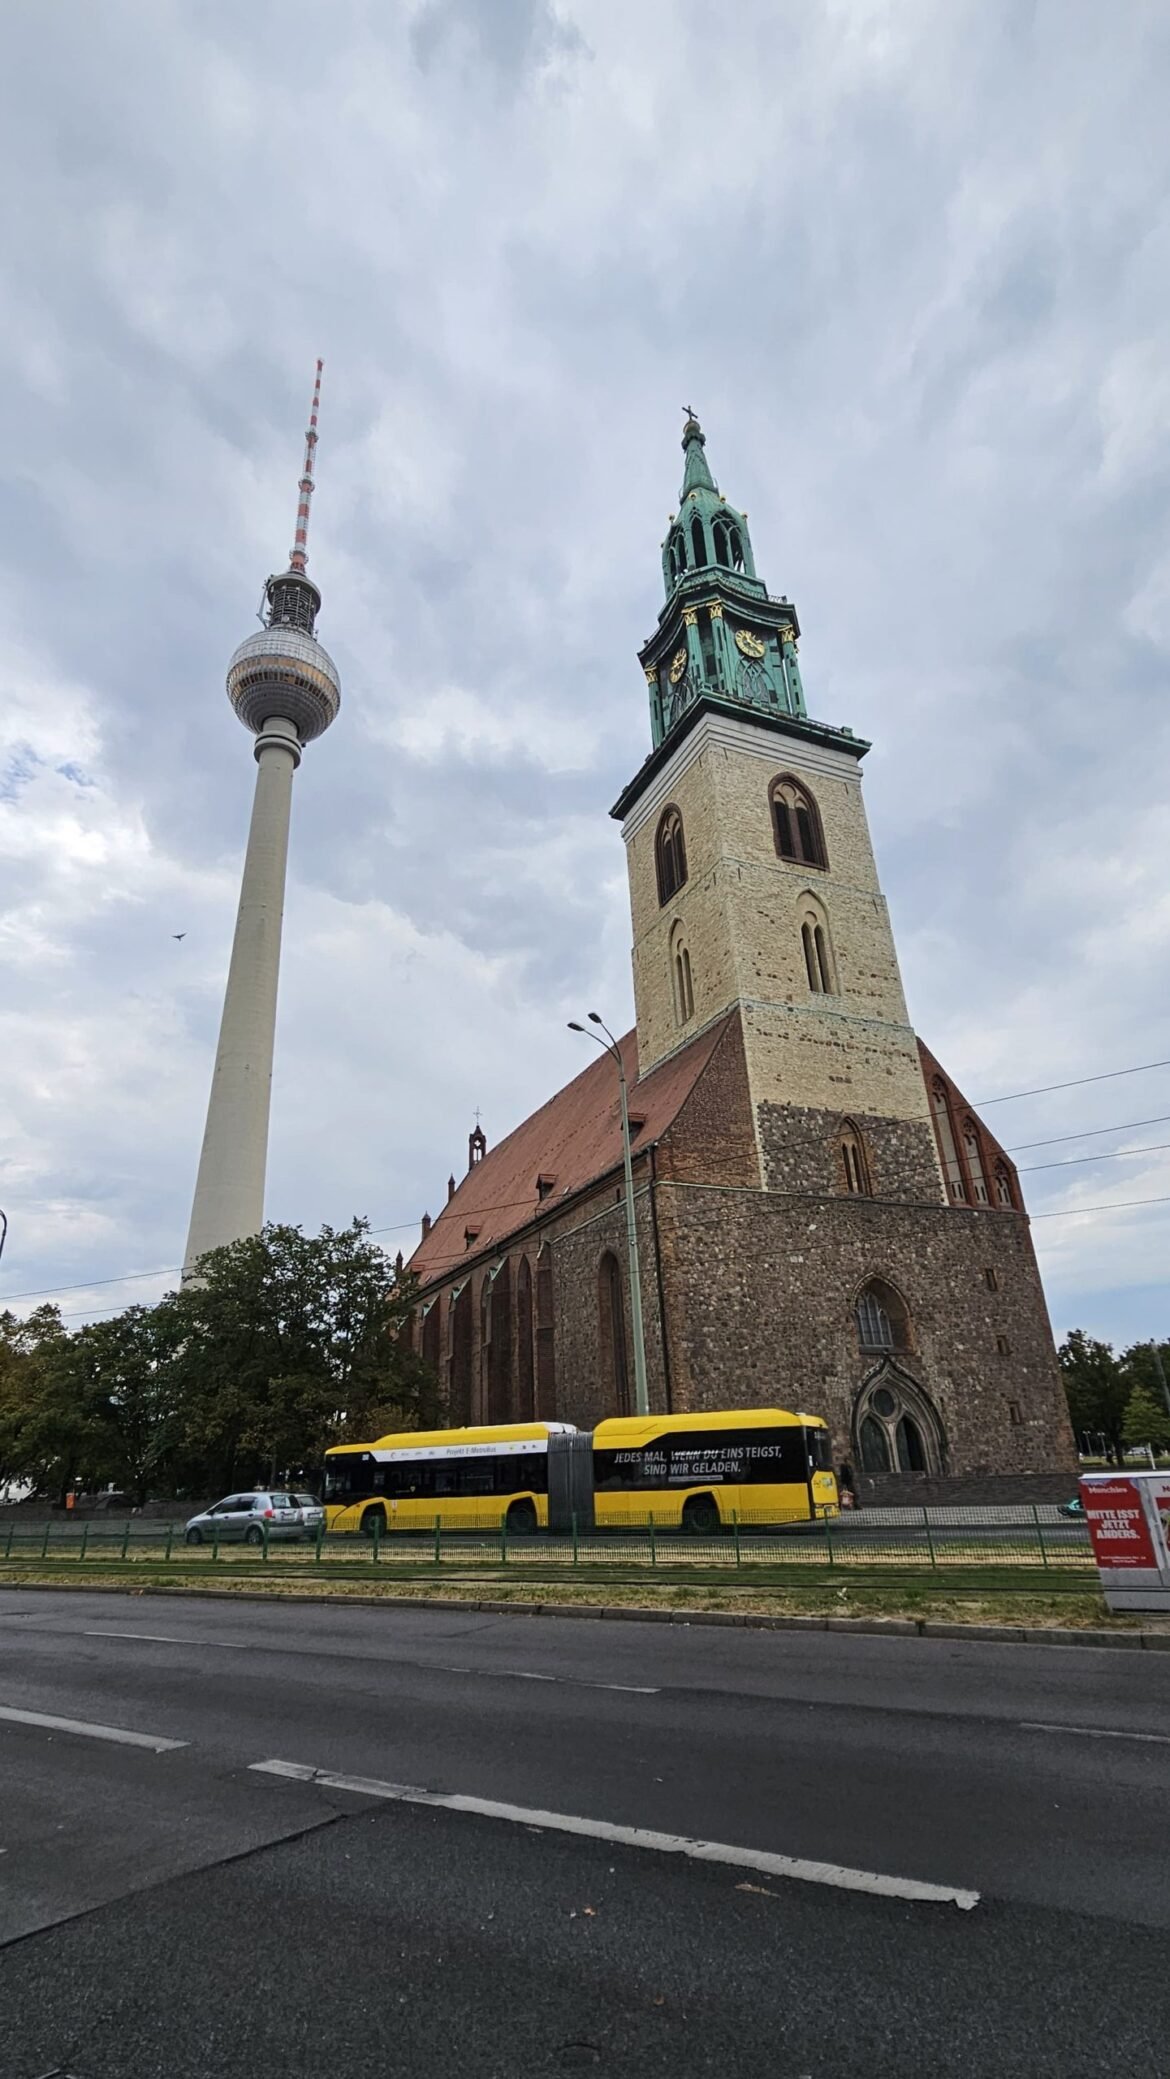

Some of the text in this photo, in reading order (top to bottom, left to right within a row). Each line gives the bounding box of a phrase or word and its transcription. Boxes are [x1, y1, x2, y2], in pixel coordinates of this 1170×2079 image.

[614, 1452, 642, 1463] JEDES
[703, 1449, 718, 1460] DU
[643, 1461, 741, 1475] SIND WIR GELADEN.
[1087, 1510, 1139, 1519] MITTE ISST
[1102, 1520, 1129, 1529] JETZT
[1097, 1530, 1140, 1538] ANDERS.
